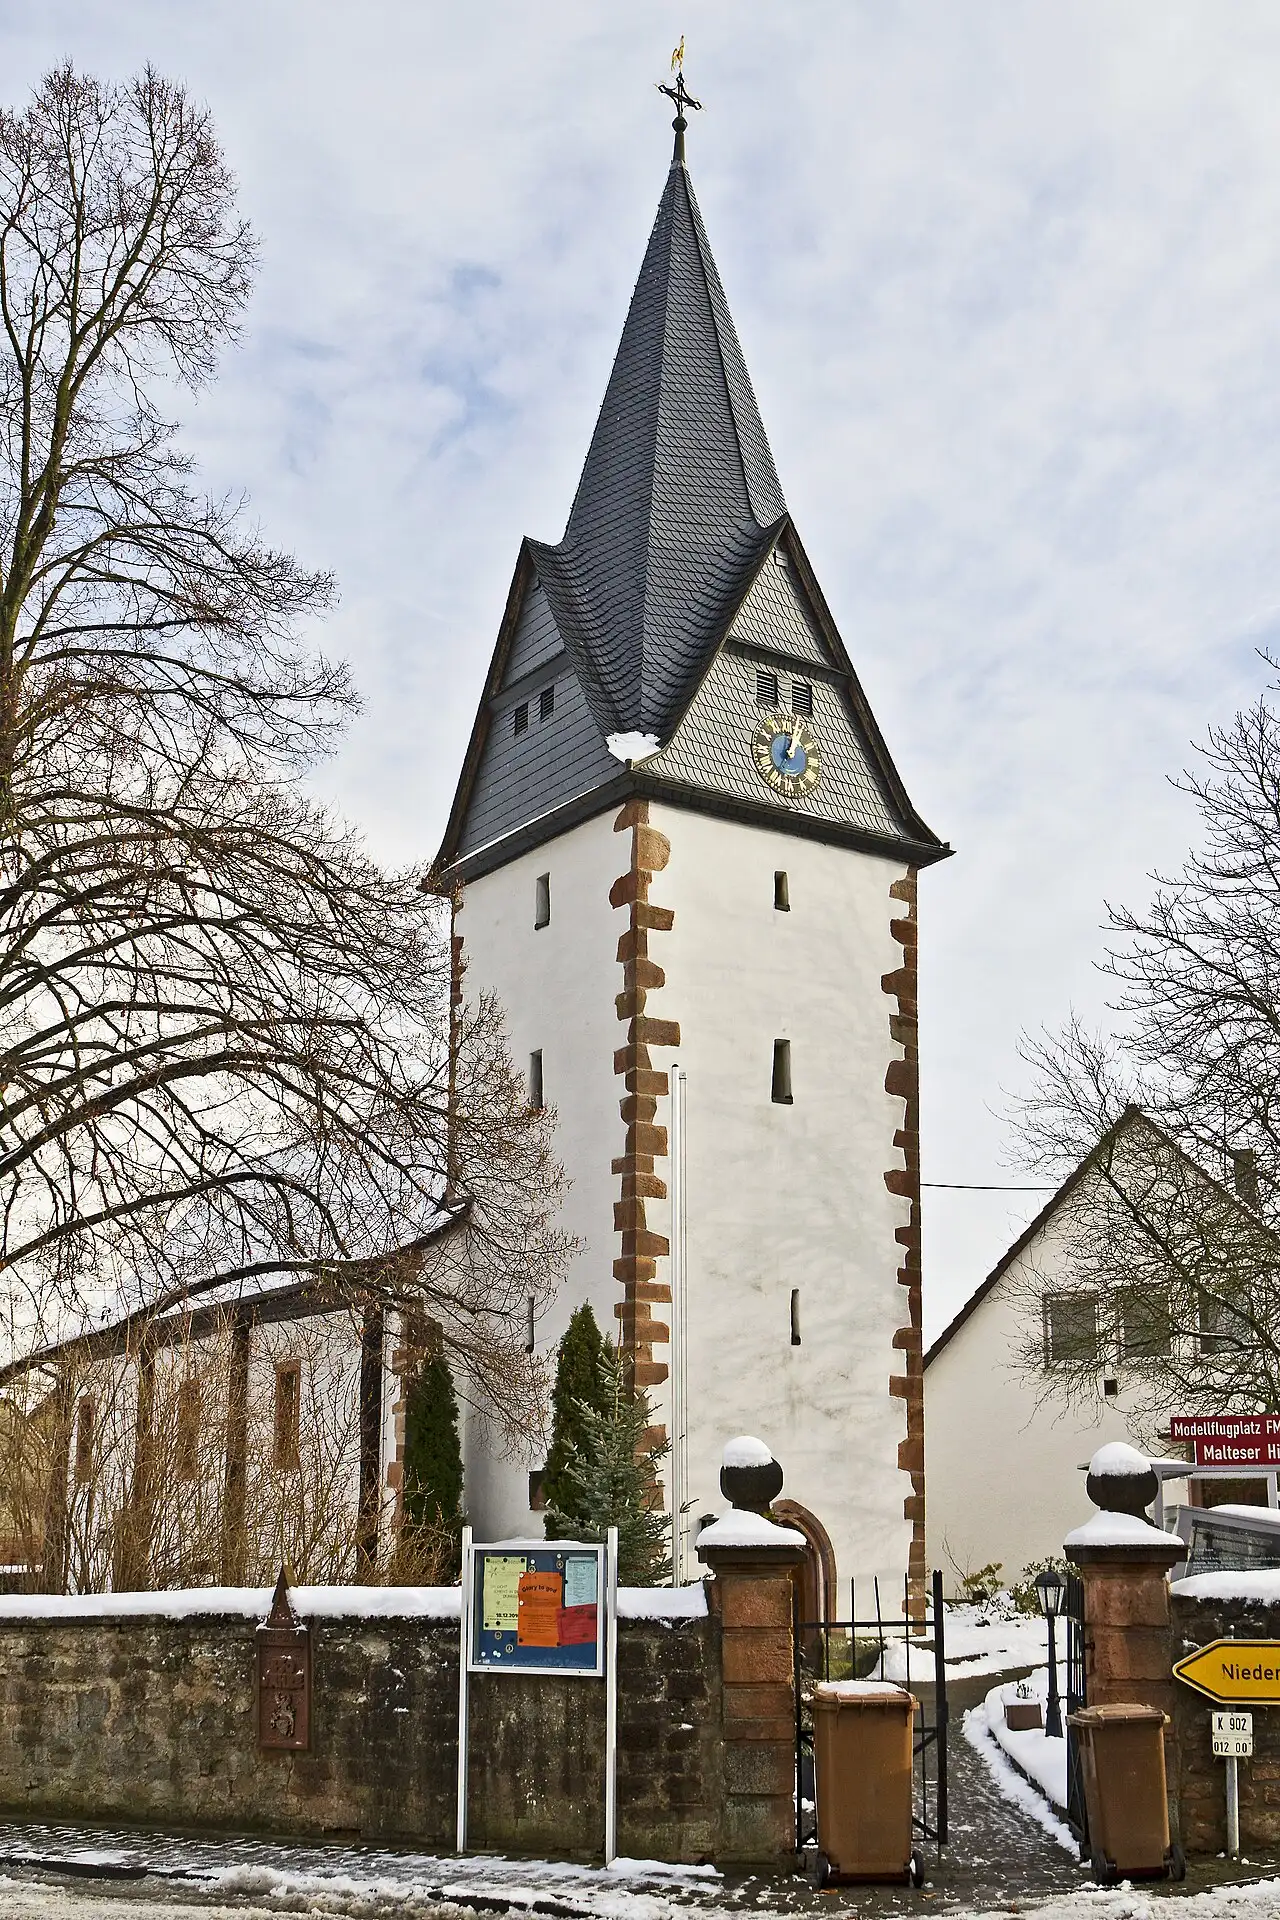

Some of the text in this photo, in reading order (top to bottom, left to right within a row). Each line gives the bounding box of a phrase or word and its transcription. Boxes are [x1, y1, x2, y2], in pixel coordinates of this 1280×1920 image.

[1174, 1421, 1261, 1438] Modellflugplatz
[1203, 1445, 1261, 1460] Malteser
[1221, 1664, 1280, 1680] Nieder
[1217, 1717, 1247, 1731] K 902
[1214, 1741, 1229, 1753] 012
